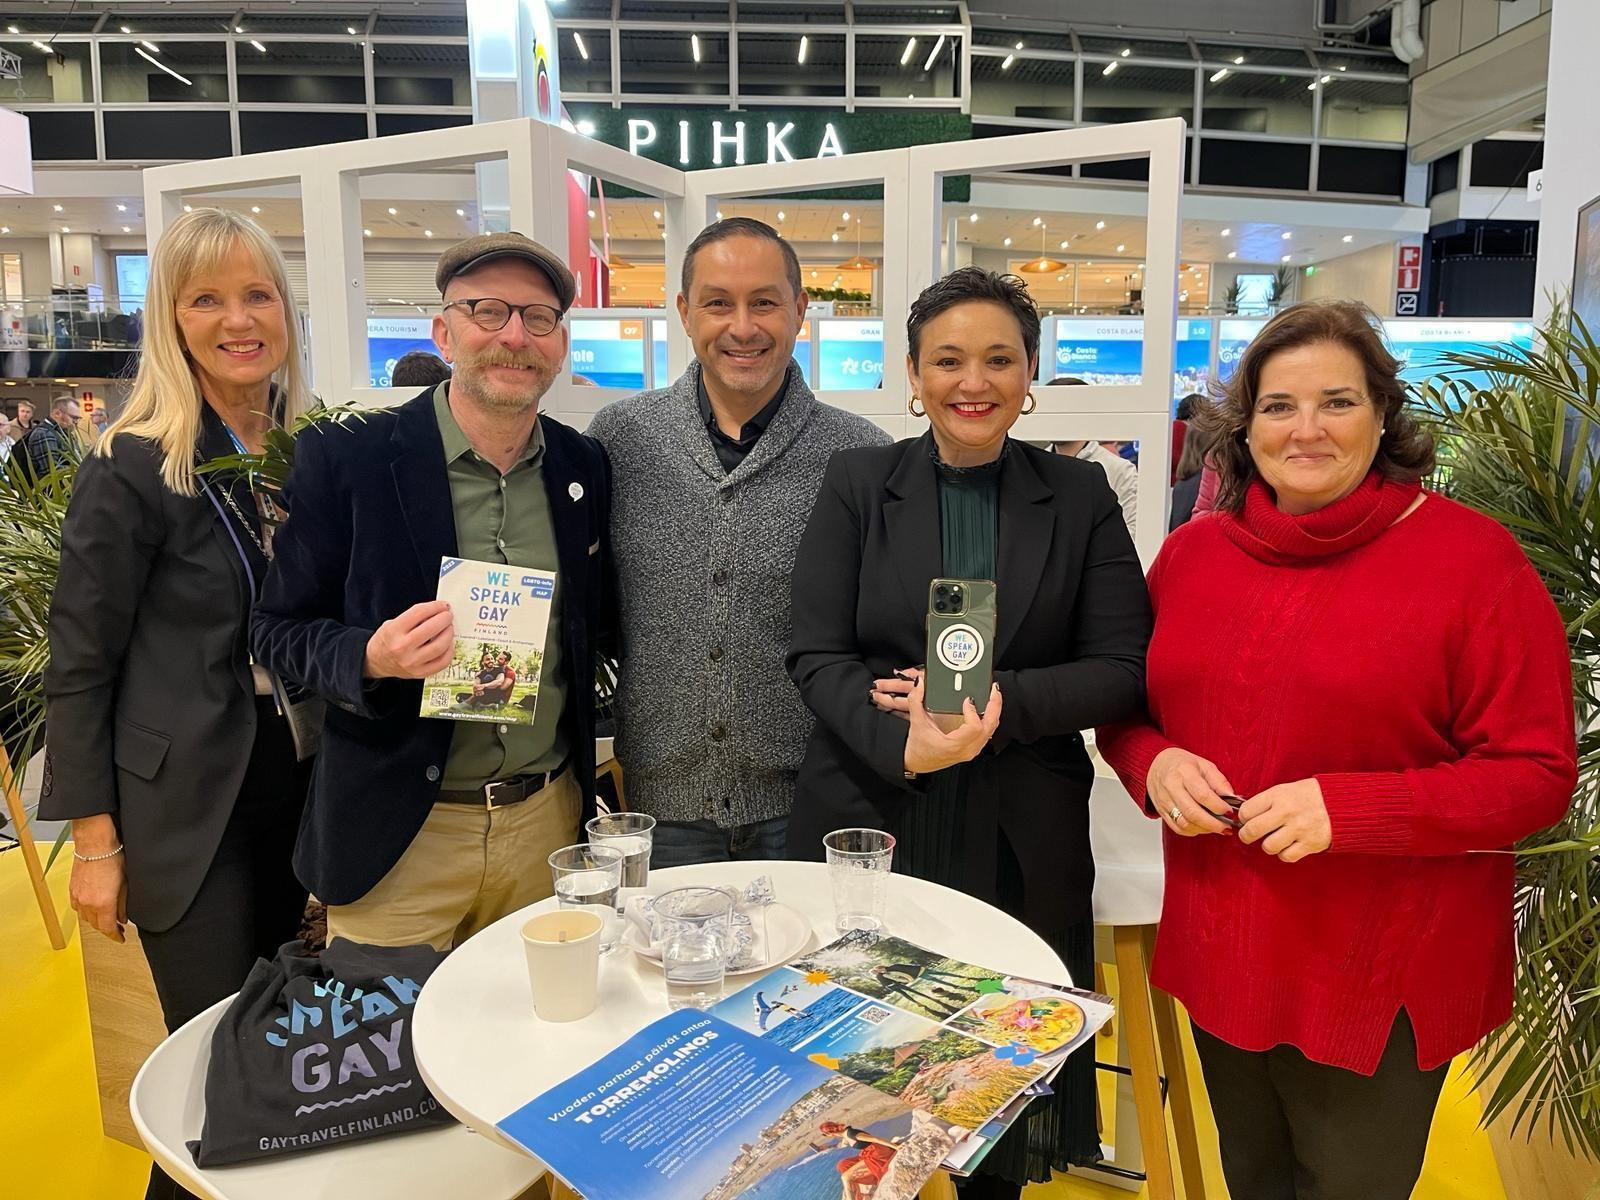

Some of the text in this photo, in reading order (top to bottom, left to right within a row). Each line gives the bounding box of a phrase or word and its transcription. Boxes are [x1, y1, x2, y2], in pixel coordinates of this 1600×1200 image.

[627, 119, 844, 165] PIHKA
[487, 570, 511, 587] WE
[470, 586, 522, 606] SPEAK
[479, 605, 509, 622] GAY
[473, 627, 508, 636] FINLAND
[955, 634, 966, 642] WE
[948, 642, 973, 651] SPEAK
[952, 651, 967, 659] GAY
[291, 1018, 404, 1094] GAY
[548, 1018, 712, 1122] Vuoden parhaat päivät antaa
[574, 1030, 719, 1125] TORREMOLINOS
[259, 1097, 440, 1151] GAYTRAVELFINLAND.CO
